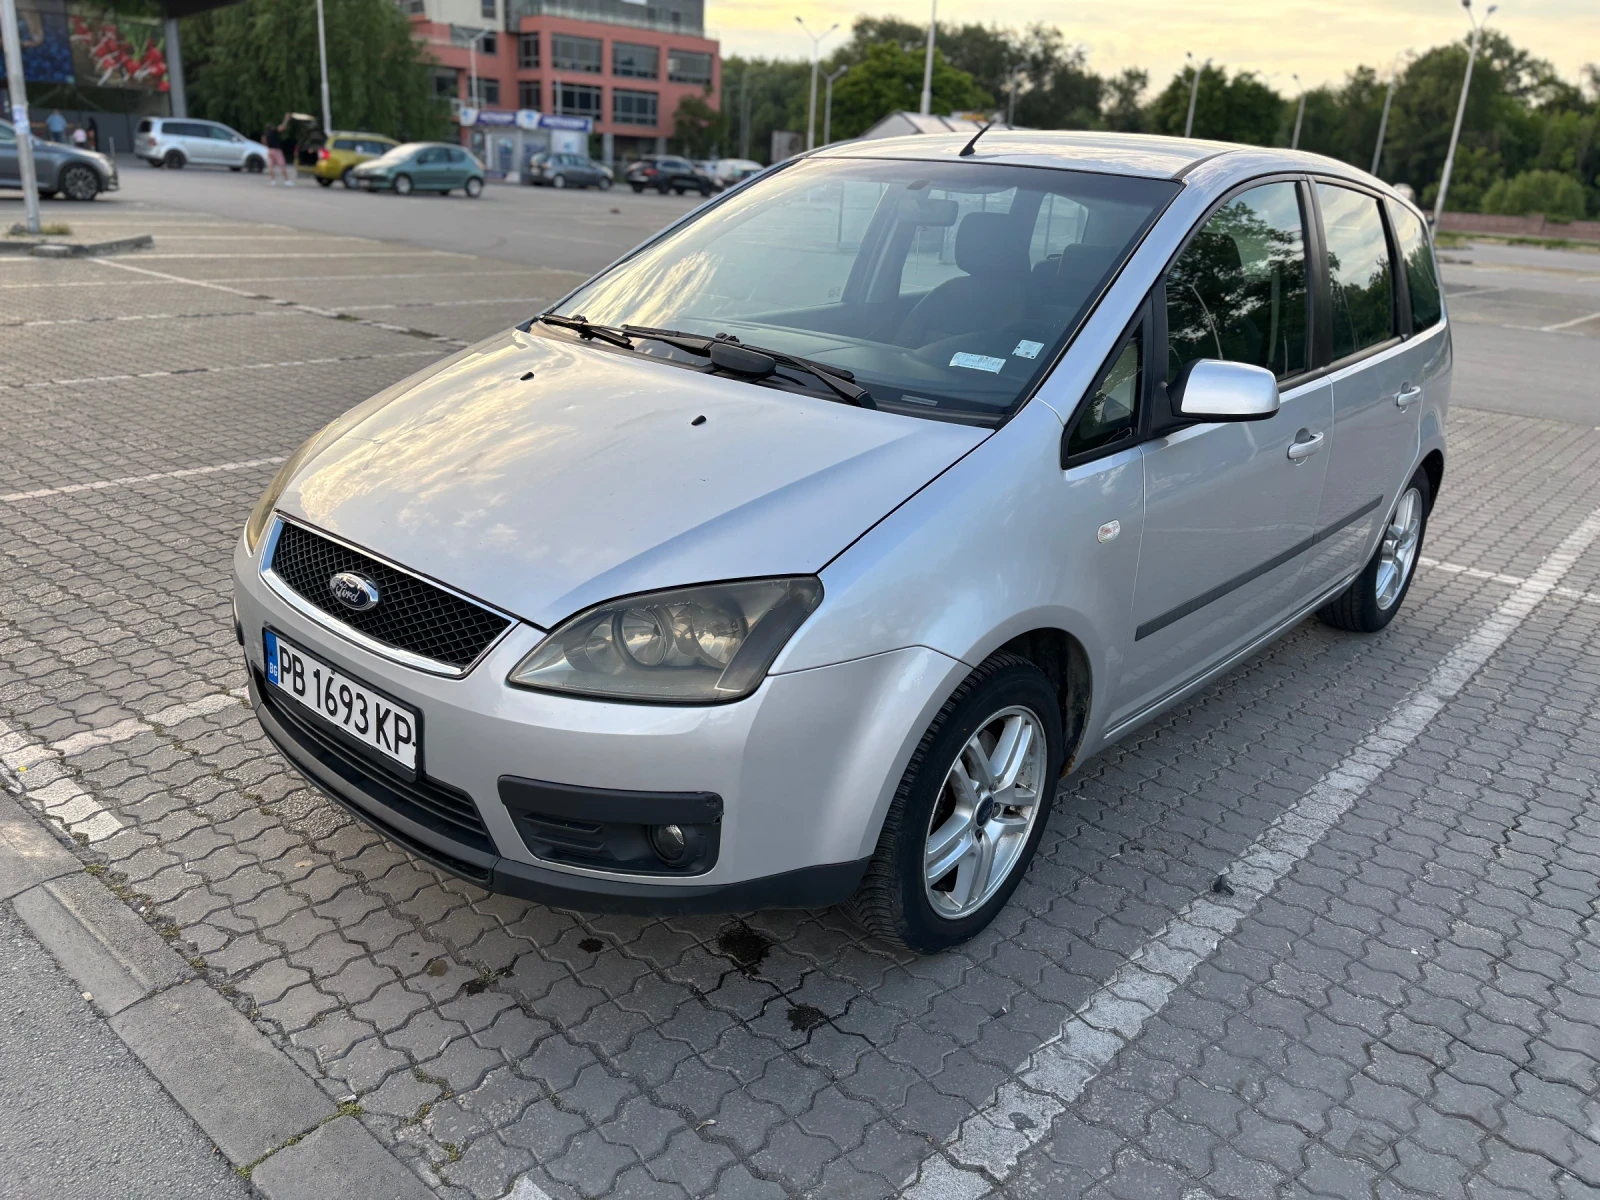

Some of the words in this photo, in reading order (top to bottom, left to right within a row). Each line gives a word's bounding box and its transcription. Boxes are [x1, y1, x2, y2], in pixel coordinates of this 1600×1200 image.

[336, 580, 360, 603] Ford
[269, 661, 278, 677] BG
[278, 644, 306, 697] PB
[313, 668, 369, 736] 1693
[375, 702, 412, 756] KP
